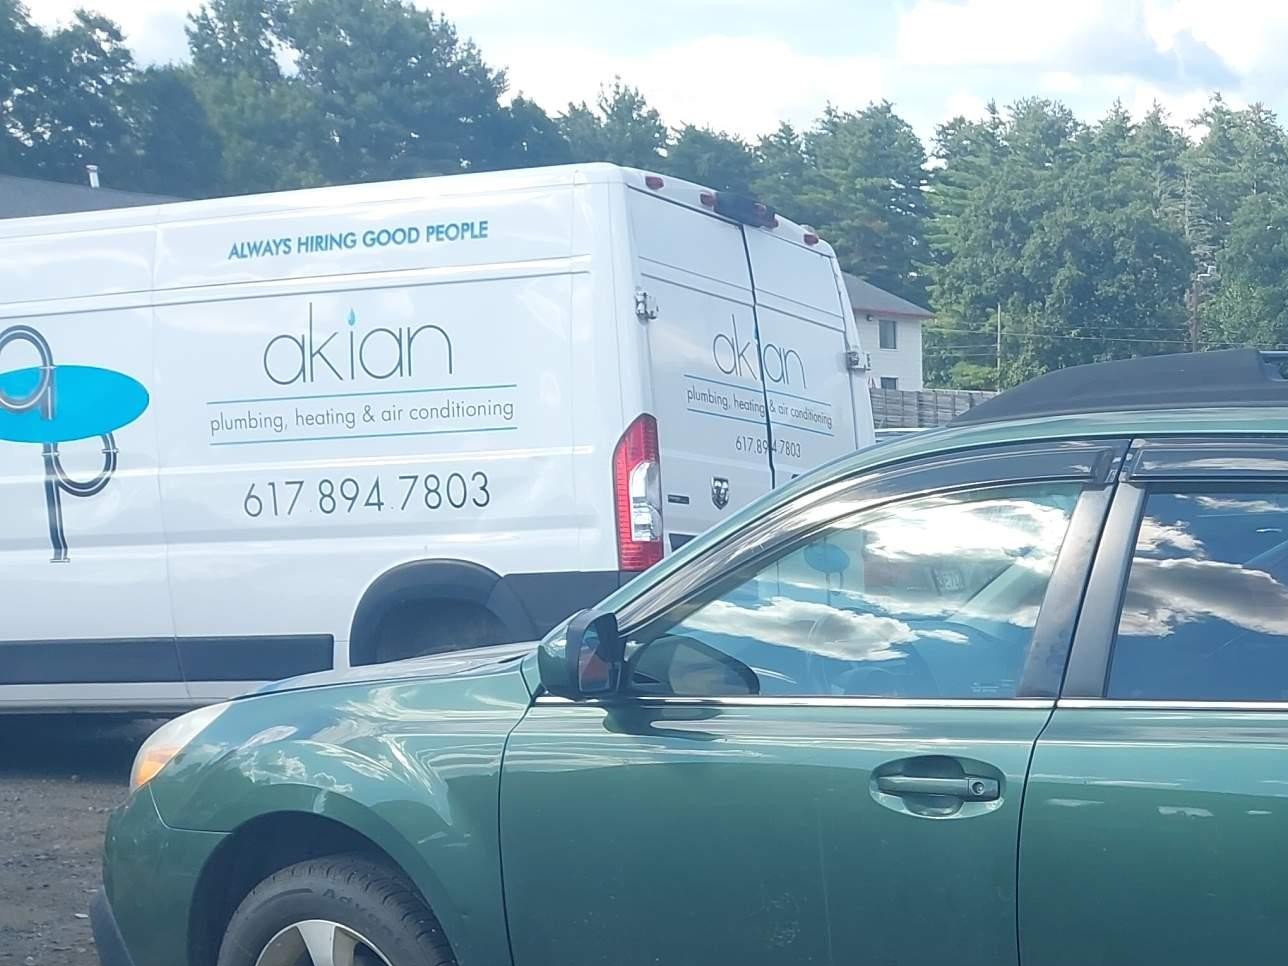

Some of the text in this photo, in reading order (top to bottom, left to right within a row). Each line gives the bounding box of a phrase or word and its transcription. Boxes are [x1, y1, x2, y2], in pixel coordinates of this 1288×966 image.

[228, 220, 489, 260] ALWAYS HIRING GOOD PEOPLE
[263, 302, 453, 385] akian
[209, 400, 514, 436] plumbing, heating & air conditioning
[687, 385, 833, 430] plumbing, heating & air conditioning
[244, 471, 491, 518] 617.894.7803
